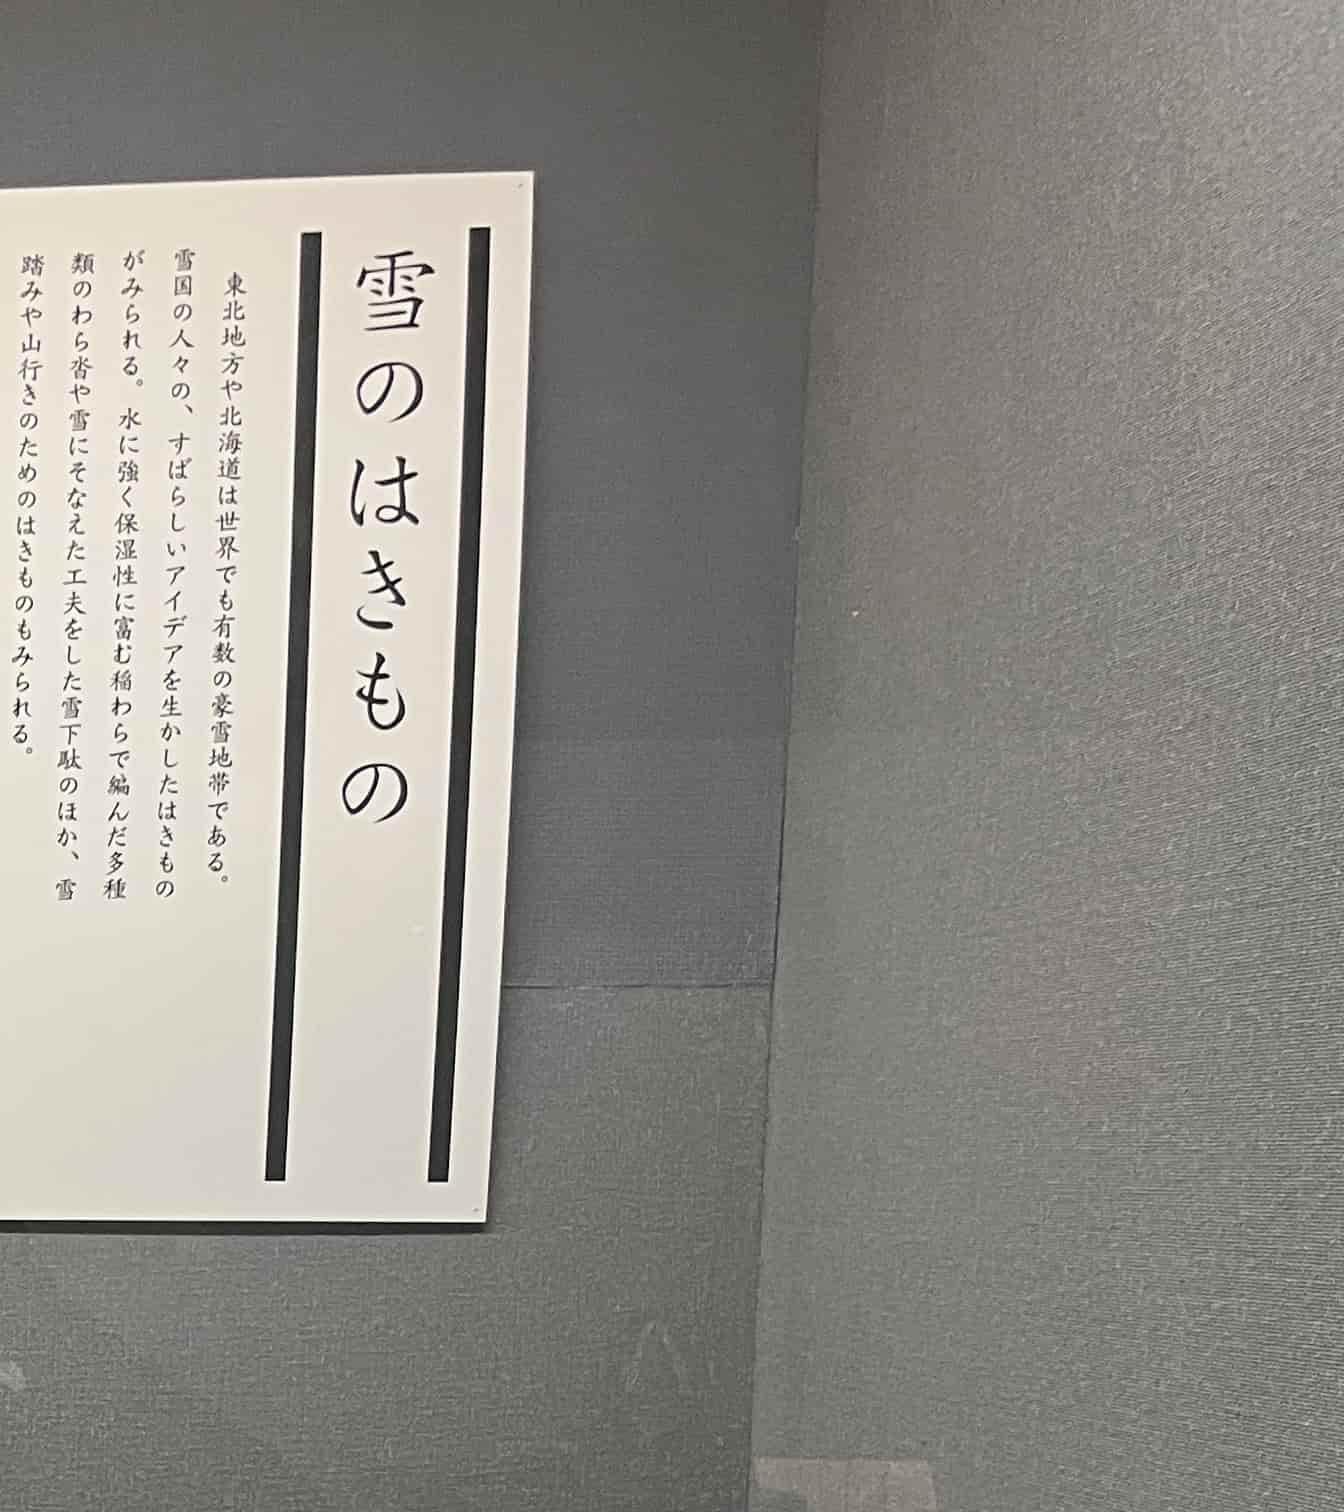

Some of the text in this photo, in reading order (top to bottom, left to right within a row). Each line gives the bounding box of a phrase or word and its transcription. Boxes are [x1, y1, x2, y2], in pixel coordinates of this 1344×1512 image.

[10, 253, 45, 755] 踏みや山行きのためのはきものもみられる。
[54, 251, 96, 901] 類のわら沓や雪にそなえた工夫をした雪下駄のほか、雪
[154, 247, 196, 898] 雪国の人々の、すばらしいアイデアを生かしたはきもの
[207, 271, 248, 885] 東北地方や北海道は世界でも有数の豪雪地帯である。
[341, 249, 436, 824] 雪のはきもの
